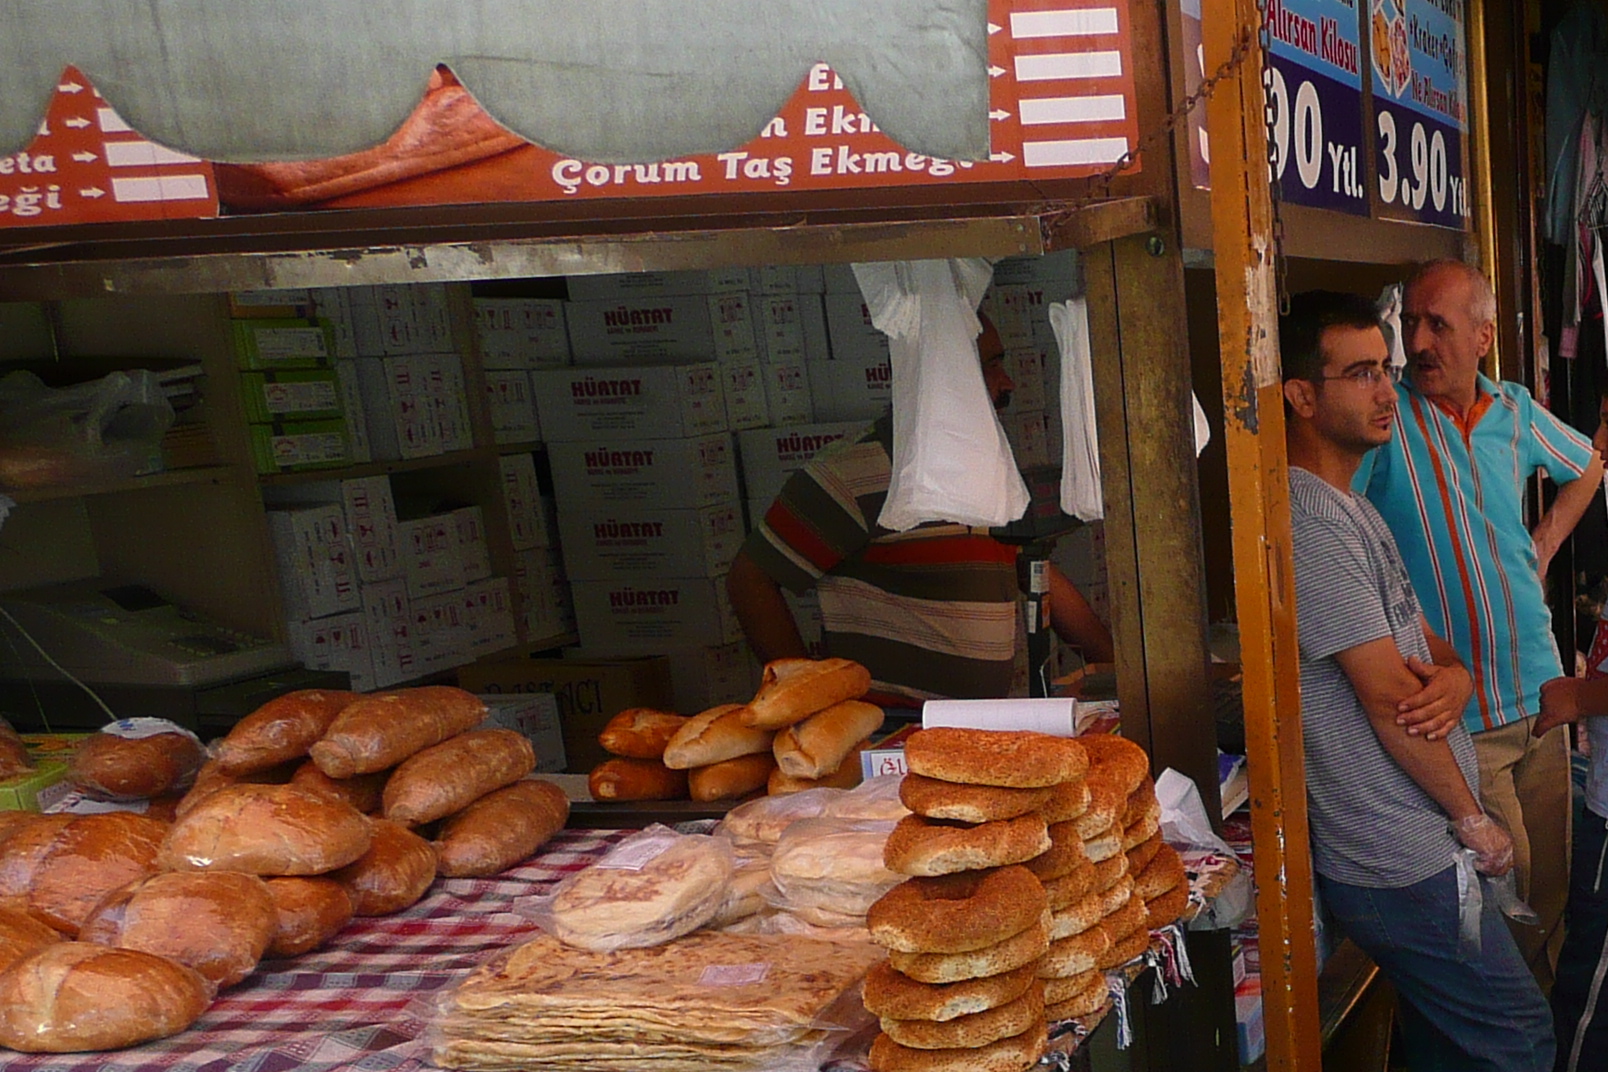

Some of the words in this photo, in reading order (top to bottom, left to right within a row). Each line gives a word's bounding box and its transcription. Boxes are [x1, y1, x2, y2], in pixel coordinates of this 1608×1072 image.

[1321, 17, 1358, 75] Kilosu
[1328, 141, 1363, 198] Ytl.
[1378, 110, 1447, 212] 3.90
[552, 157, 700, 194] Çorum
[718, 151, 793, 185] Taş
[604, 305, 673, 327] HÜRTAT
[571, 376, 642, 397] HÜRTAT
[584, 447, 654, 468] HÜRTAT
[594, 518, 663, 539] HÜRTAT
[609, 587, 679, 606] HÜRTAT
